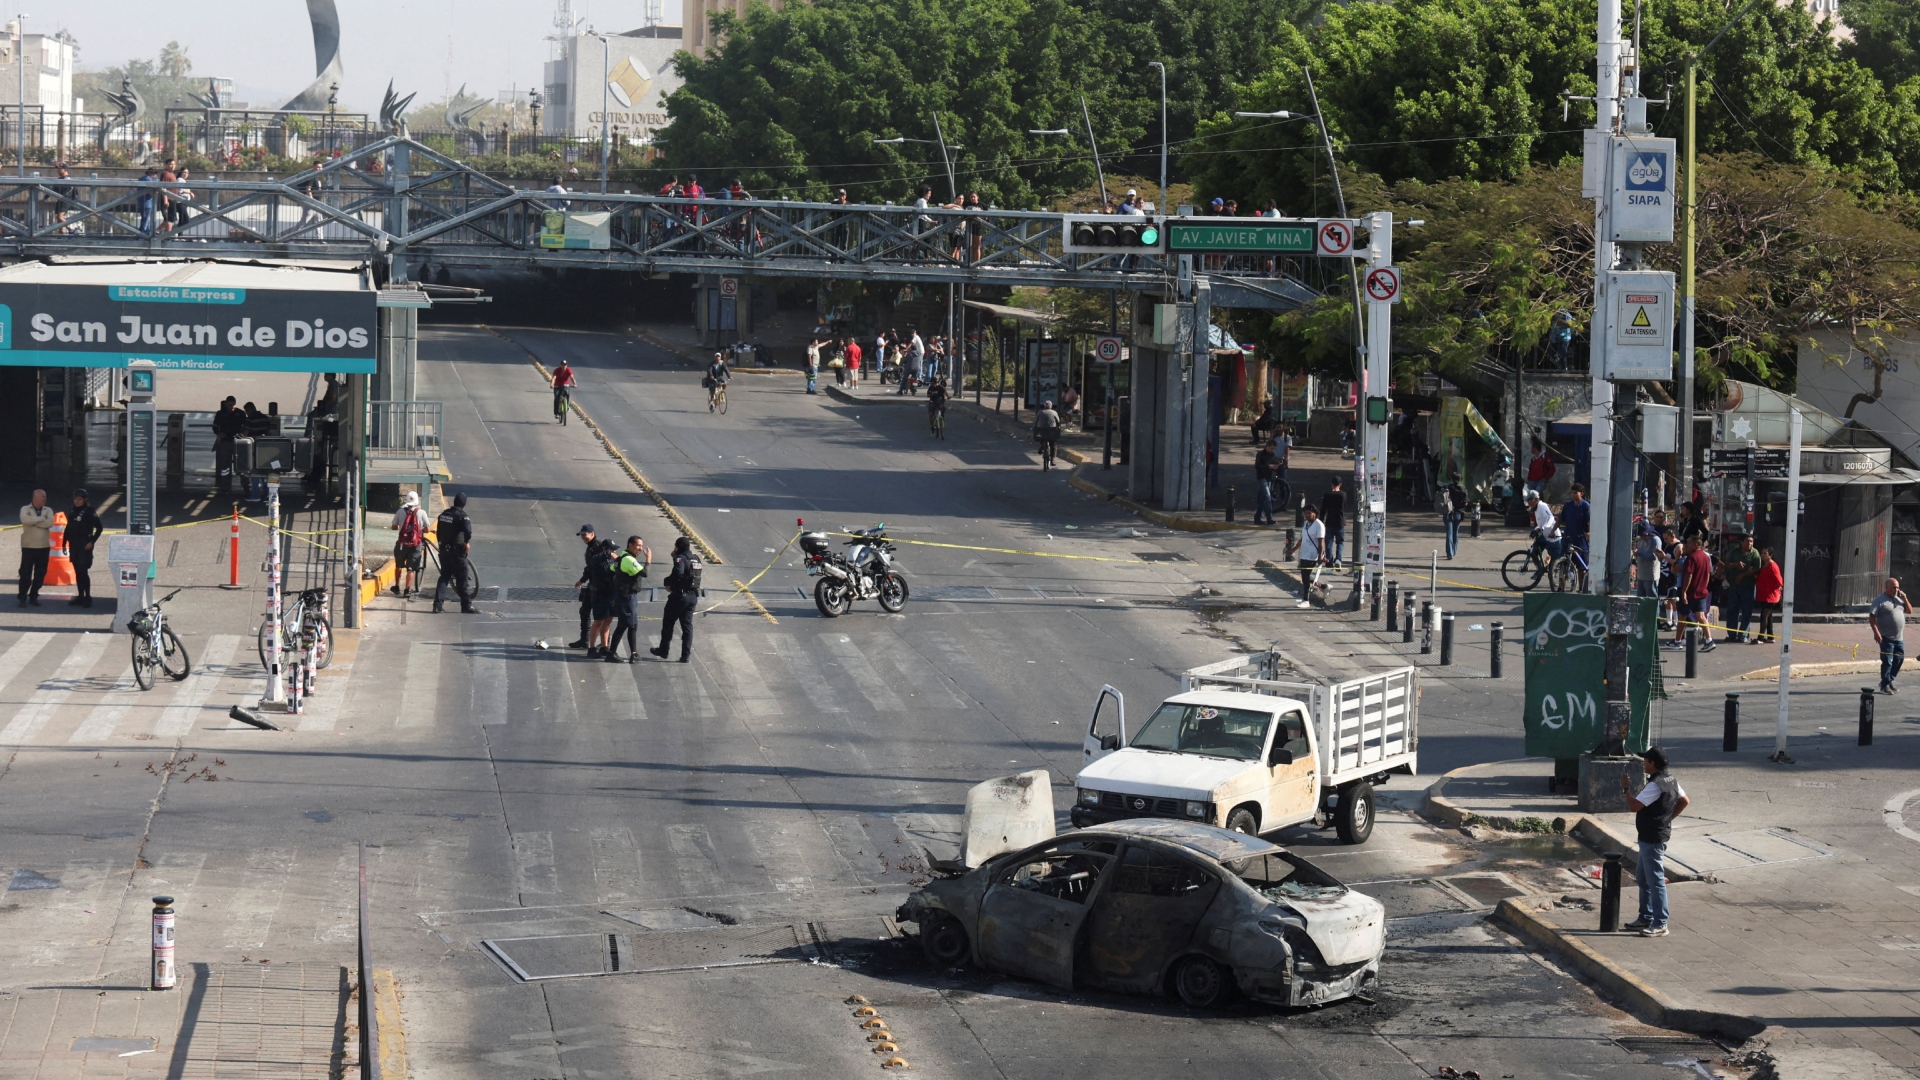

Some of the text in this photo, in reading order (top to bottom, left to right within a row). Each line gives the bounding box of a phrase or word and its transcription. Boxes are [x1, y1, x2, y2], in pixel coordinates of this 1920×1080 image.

[631, 112, 667, 125] JOYERO
[1632, 168, 1659, 179] agua
[1628, 194, 1661, 206] SIAPA
[1181, 231, 1302, 245] AV. JAVIER MINA
[118, 286, 236, 302] Estación Express
[30, 312, 369, 349] San Juan de Dios
[1637, 328, 1658, 336] TENSION
[1103, 343, 1115, 354] 50
[128, 357, 225, 370] Dción Mirador
[1864, 356, 1899, 373] BOS
[1843, 462, 1873, 470] 12016070
